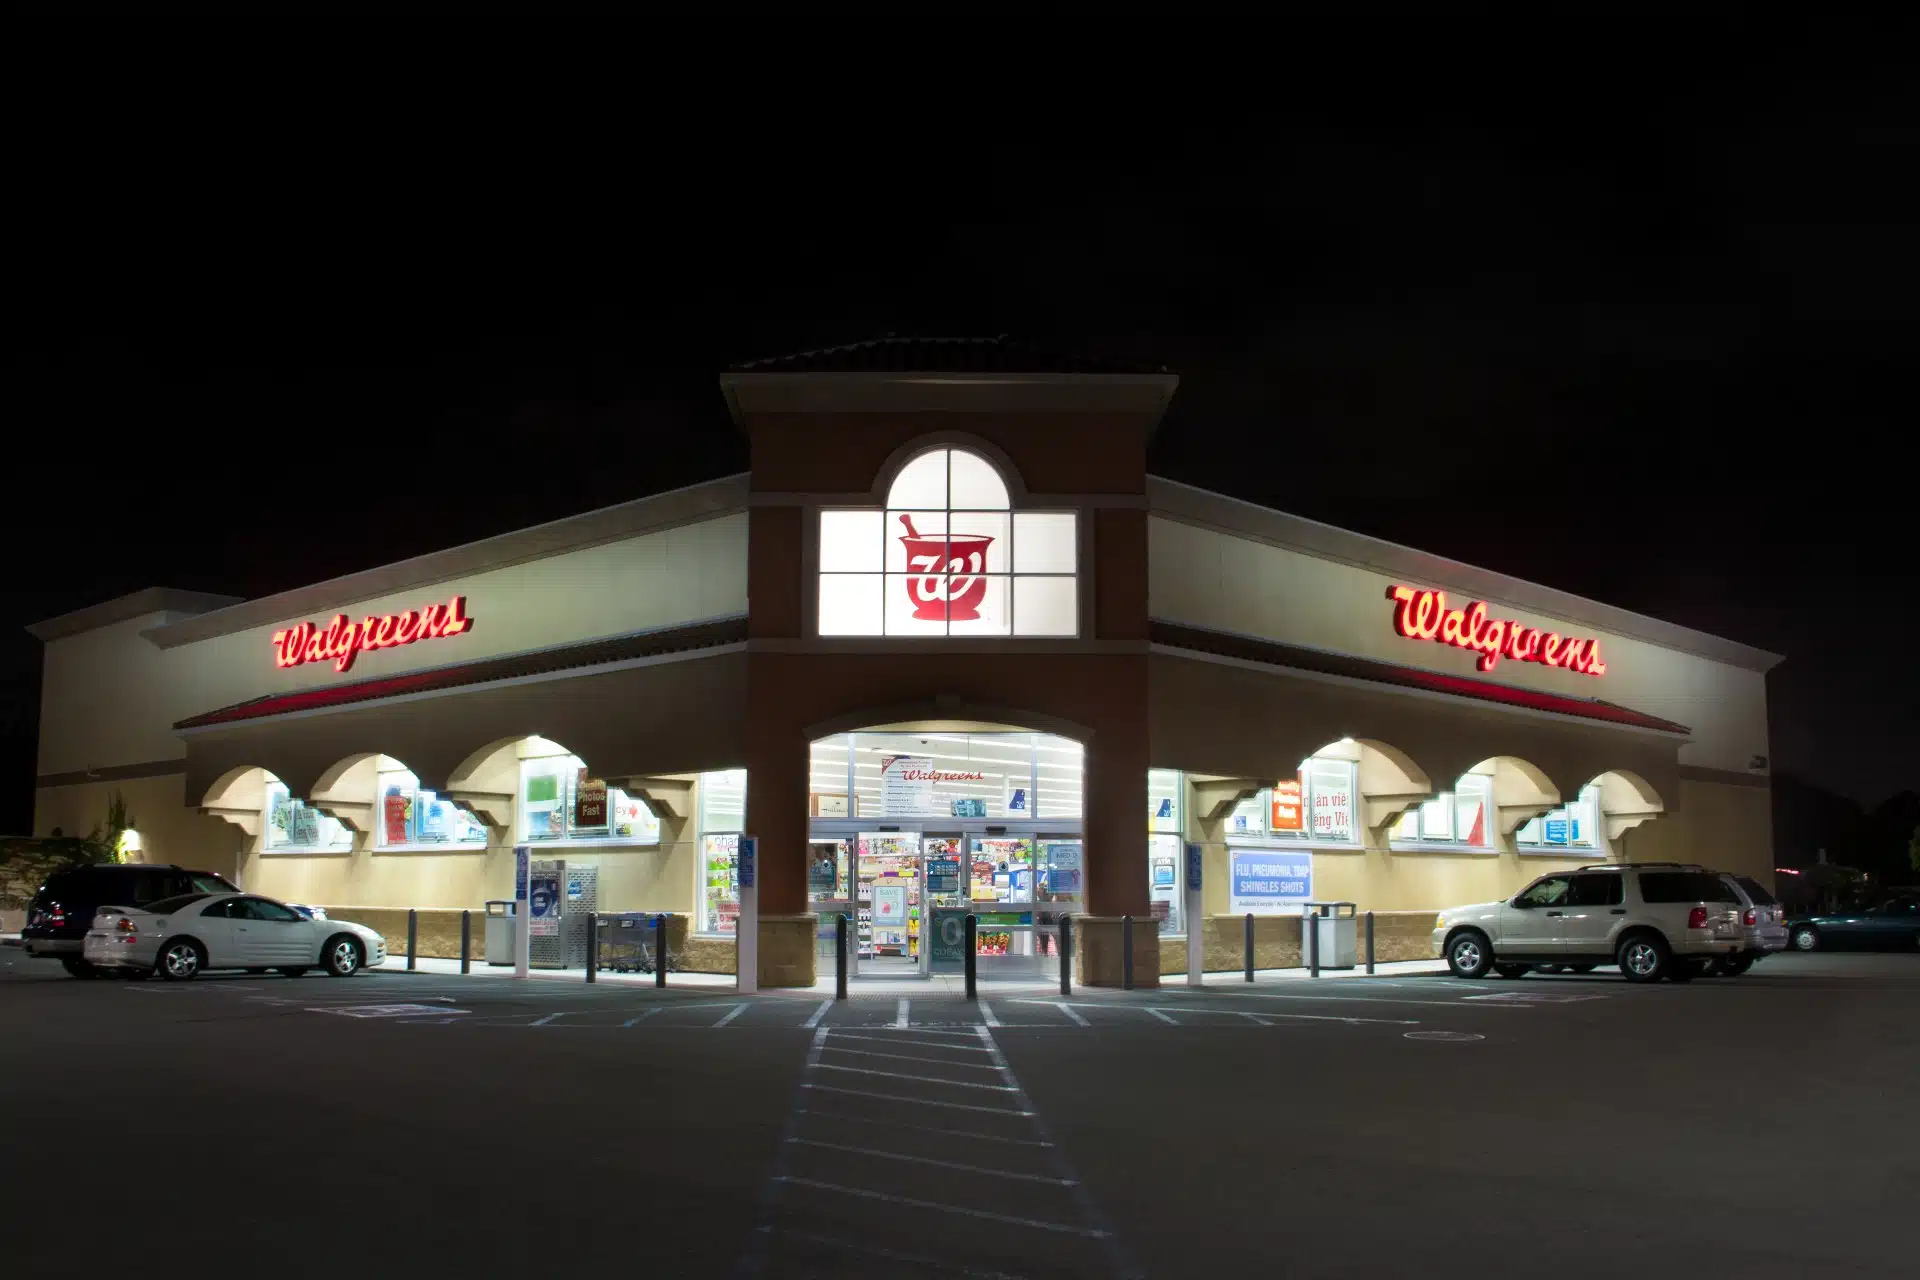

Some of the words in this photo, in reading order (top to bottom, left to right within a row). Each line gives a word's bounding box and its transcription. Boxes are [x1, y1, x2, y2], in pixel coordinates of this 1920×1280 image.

[272, 596, 474, 672] Walgreens
[1385, 585, 1607, 675] Walgreens
[902, 769, 985, 785] Walgreens
[577, 791, 606, 803] Photos
[582, 804, 600, 817] Fast
[1157, 857, 1171, 865] ATM
[1240, 881, 1279, 893] SHINGLES
[1280, 881, 1305, 893] SHOTS
